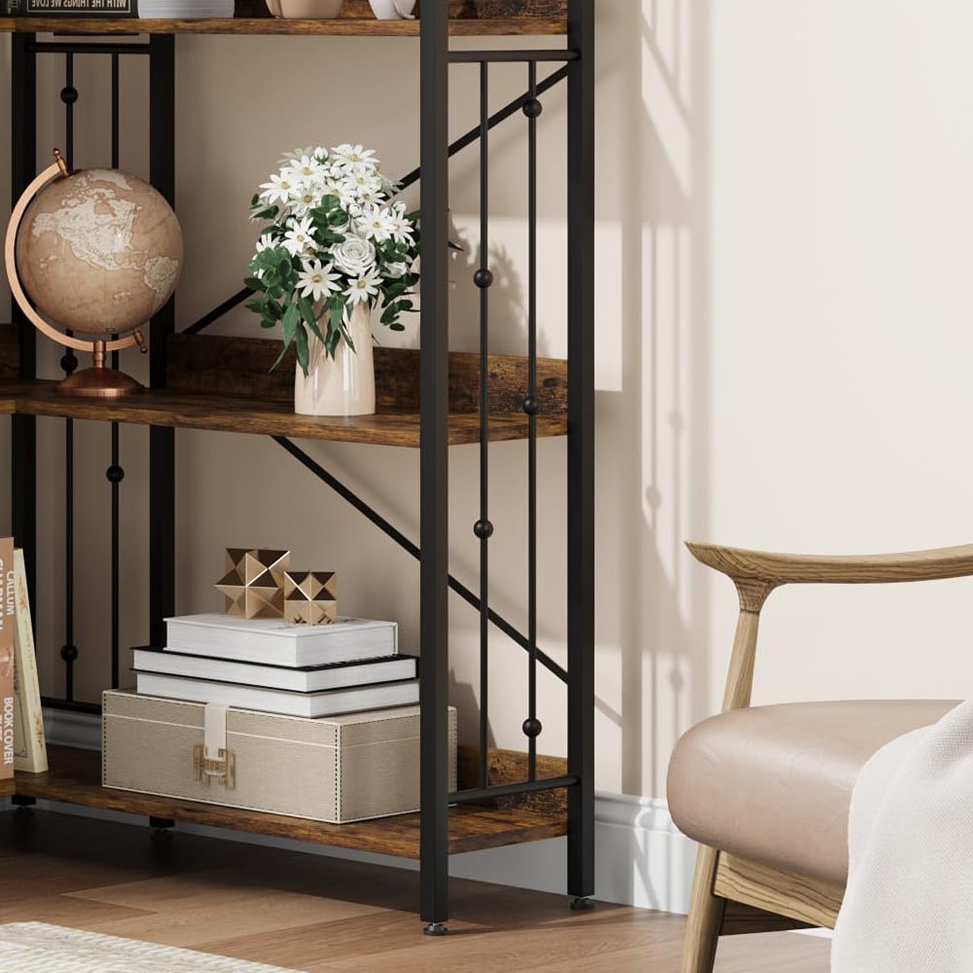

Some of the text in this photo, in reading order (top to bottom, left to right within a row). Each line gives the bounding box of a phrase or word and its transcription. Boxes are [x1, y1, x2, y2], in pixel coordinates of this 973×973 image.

[6, 570, 15, 615] CALLUM
[3, 696, 14, 765] BOOK COVER
